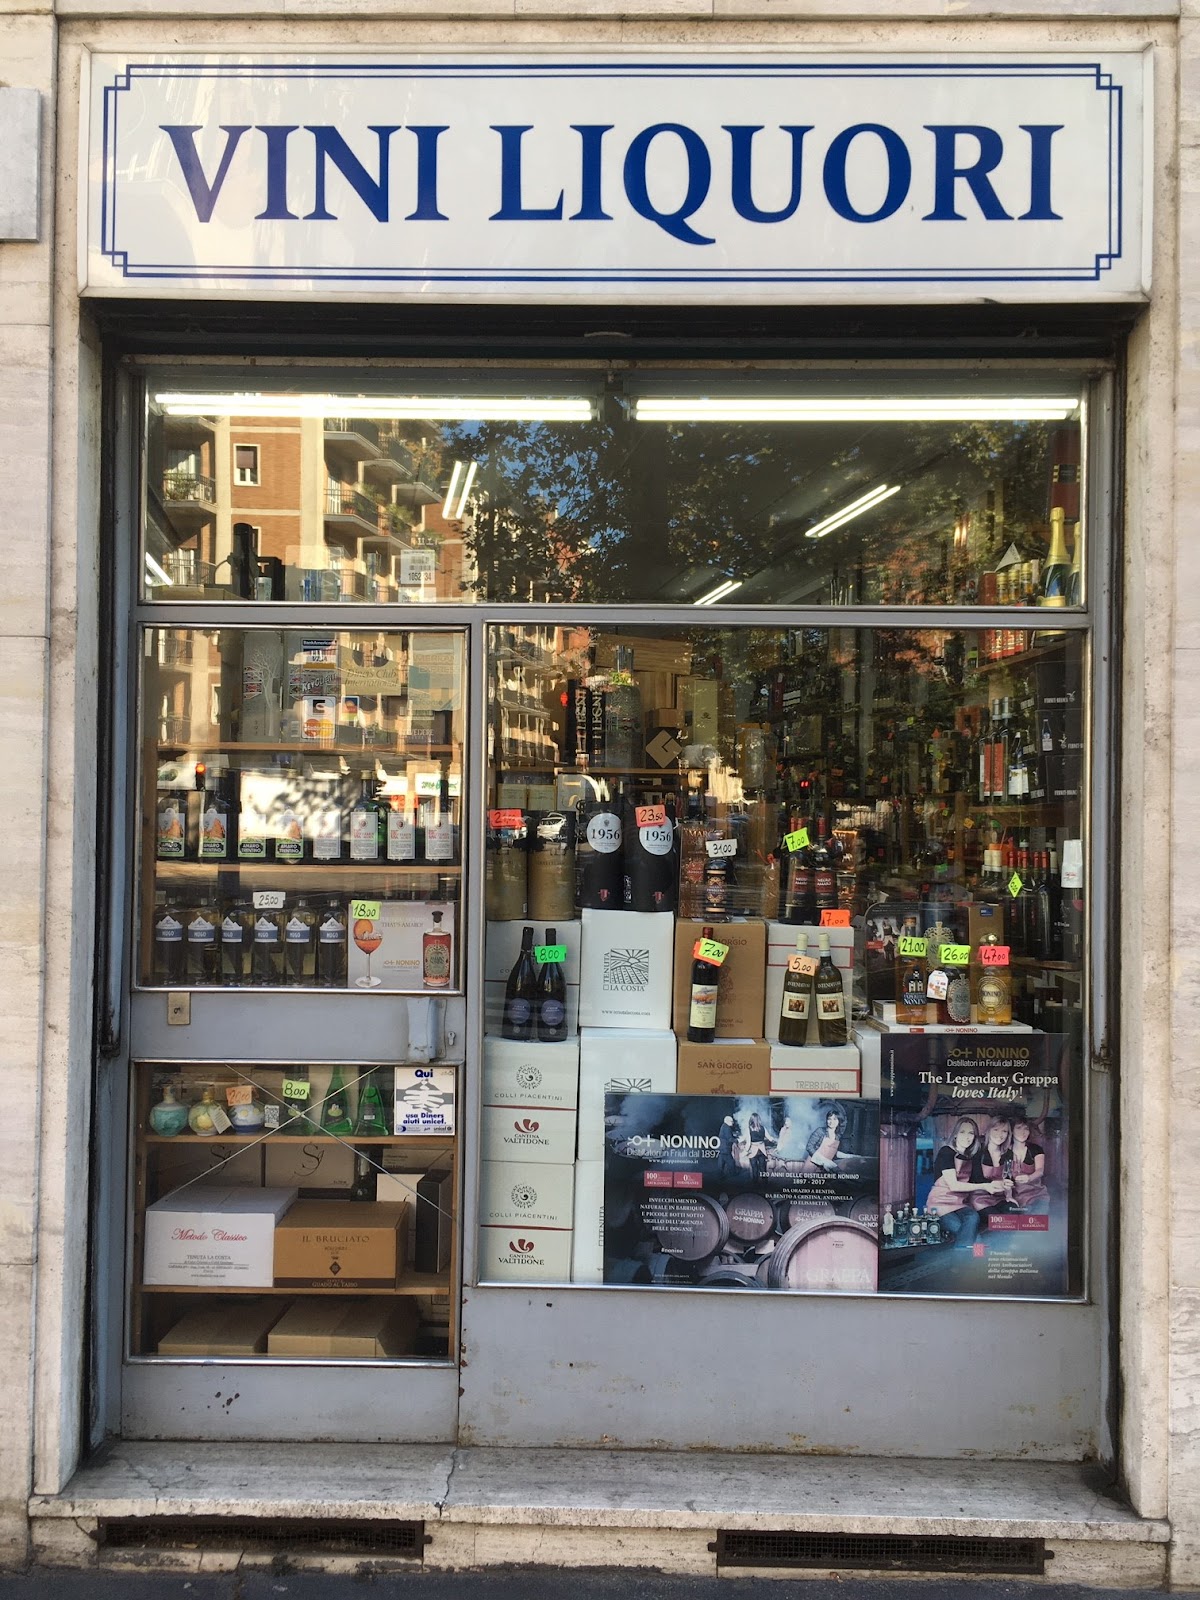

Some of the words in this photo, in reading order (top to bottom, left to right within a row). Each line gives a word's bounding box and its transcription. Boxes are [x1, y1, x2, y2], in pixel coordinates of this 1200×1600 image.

[158, 124, 453, 224] VINI
[488, 121, 1065, 247] LIQUORI
[376, 668, 397, 678] Club
[591, 828, 620, 840] 1956
[645, 830, 672, 842] 1956
[620, 984, 646, 992] COSTA
[976, 1047, 1030, 1059] NONINO
[697, 1061, 715, 1069] SAN
[716, 1061, 753, 1070] GIORGIO
[946, 1059, 979, 1067] Distillatori
[978, 1059, 986, 1067] in
[986, 1059, 1002, 1067] Friuli
[1001, 1059, 1013, 1067] dal
[414, 1068, 434, 1078] Qui
[918, 1071, 943, 1084] The
[945, 1071, 1010, 1086] Legendary
[1012, 1072, 1059, 1088] Grappa
[795, 1080, 840, 1090] TREBBIANO
[519, 1093, 564, 1101] PIACENTINI
[951, 1085, 985, 1099] loves
[986, 1085, 1024, 1102] Italy!
[503, 1137, 550, 1146] VALTIDONE
[659, 1134, 721, 1150] NONINO
[670, 1148, 688, 1158] Friuli
[688, 1149, 700, 1158] dal
[701, 1149, 721, 1159] 1897
[646, 1172, 658, 1180] 100
[514, 1213, 559, 1221] PIACENTINI
[735, 1208, 764, 1219] GRAPPA
[743, 1216, 765, 1225] NONINO
[171, 1227, 208, 1241] Metodo
[211, 1228, 248, 1242] Classico
[302, 1235, 309, 1243] IL
[316, 1235, 370, 1243] BRUCIATO
[498, 1257, 545, 1266] VALTIDONE
